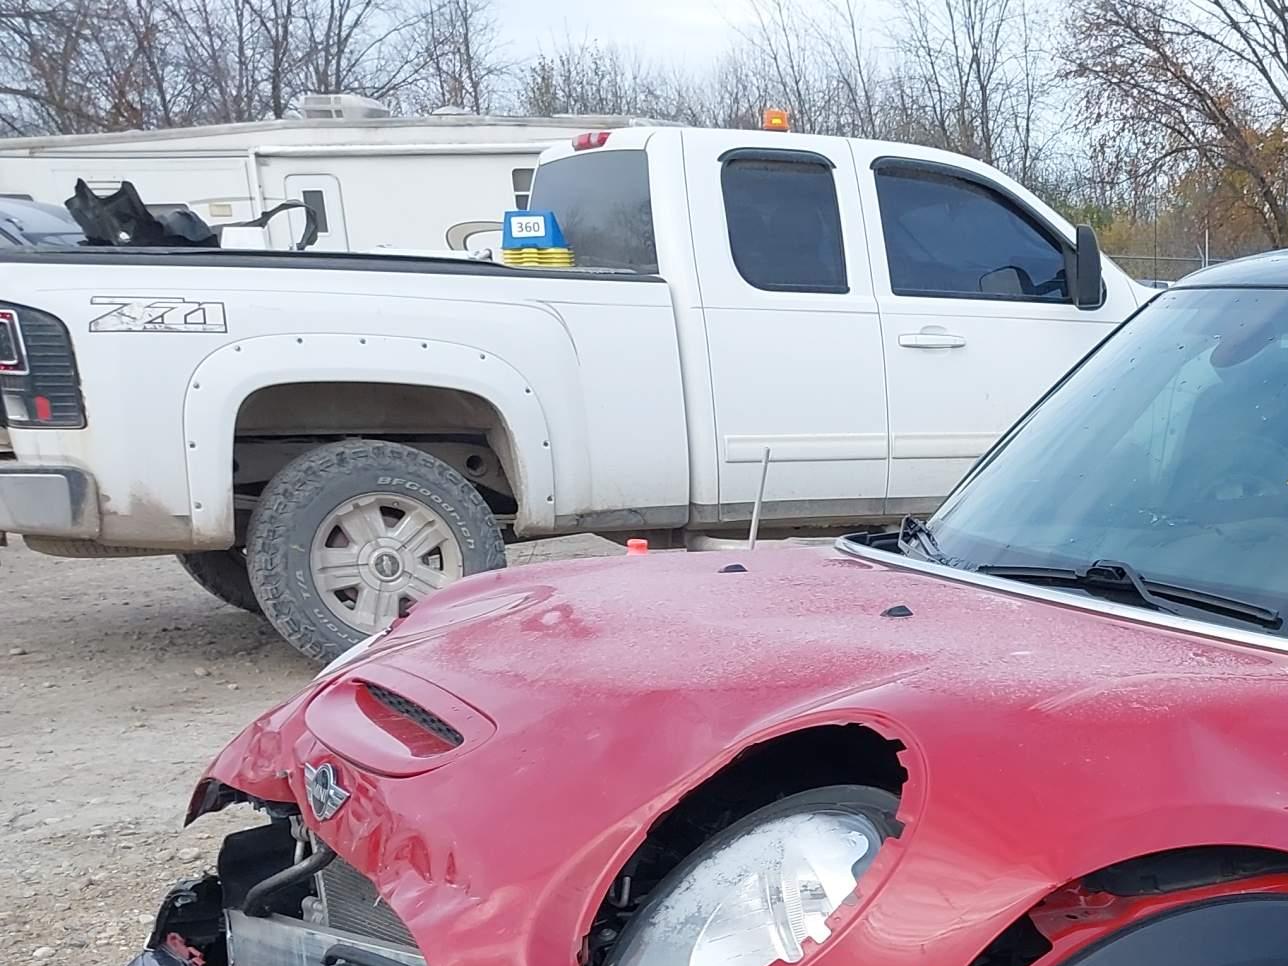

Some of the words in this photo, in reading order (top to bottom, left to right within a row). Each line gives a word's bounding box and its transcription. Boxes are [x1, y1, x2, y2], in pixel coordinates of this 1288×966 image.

[516, 222, 540, 233] 360
[89, 296, 228, 333] Z71
[376, 476, 476, 550] BFGoodrich
